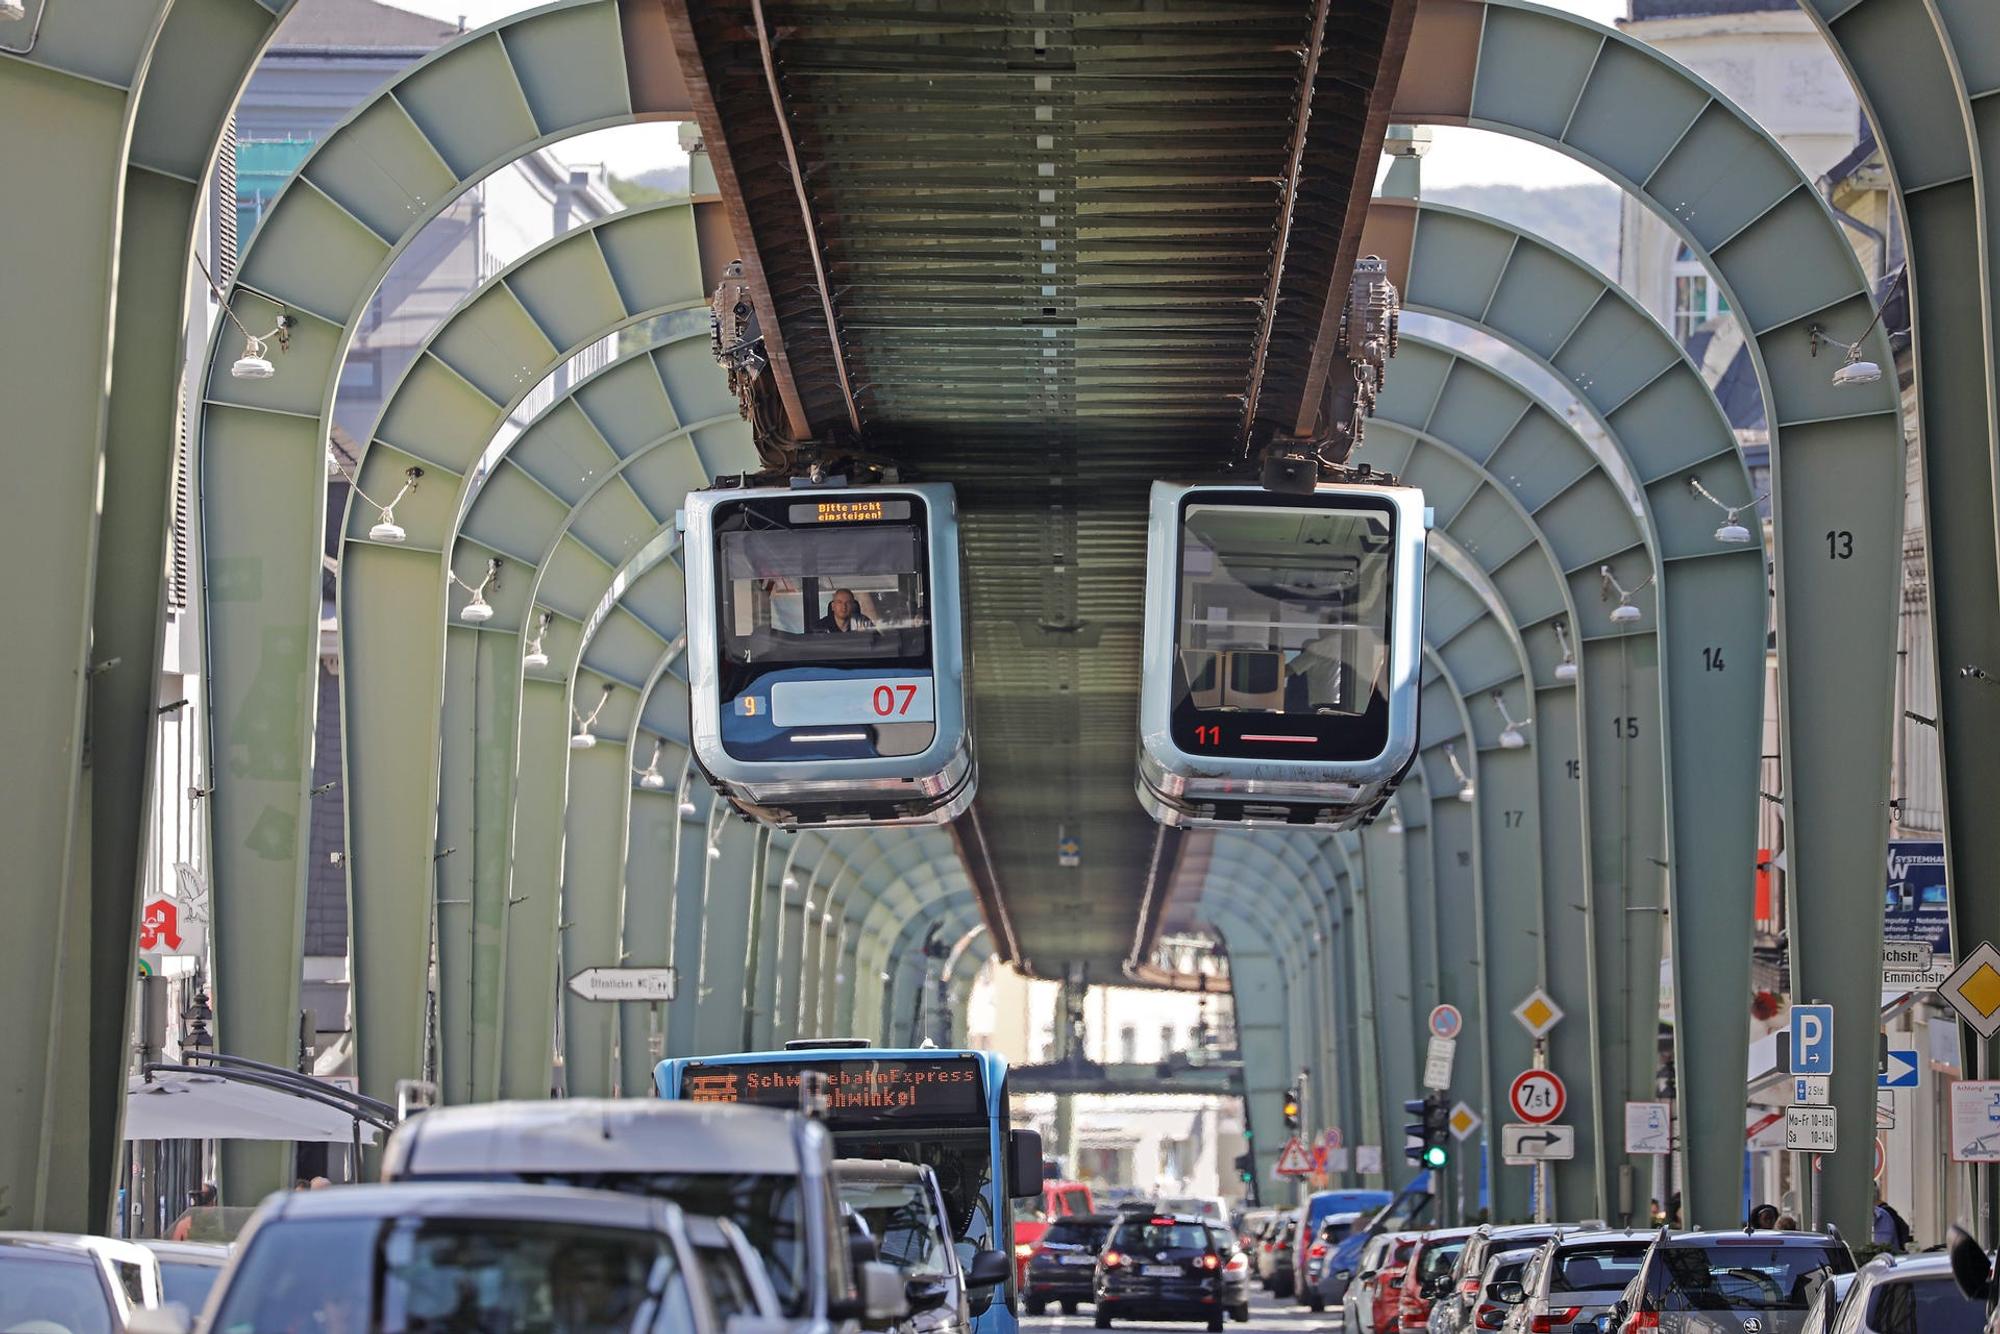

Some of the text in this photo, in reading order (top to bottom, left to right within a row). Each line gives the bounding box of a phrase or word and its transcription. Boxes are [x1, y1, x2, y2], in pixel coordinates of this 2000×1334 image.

[818, 501, 881, 513] Bitte nicht
[818, 511, 882, 521] einsteigen!
[1825, 530, 1853, 559] 13
[1702, 647, 1725, 672] 14
[744, 696, 756, 717] 9
[873, 684, 918, 717] 07
[1194, 725, 1220, 746] 11
[1613, 717, 1639, 739] 15
[1503, 810, 1524, 828] 17
[1895, 855, 1945, 863] SYSTEMHA
[1882, 949, 1918, 962] ichstr.
[1800, 1014, 1823, 1066] P
[747, 1069, 976, 1088] SchwebahnExpress
[1788, 1130, 1797, 1143] Sa
